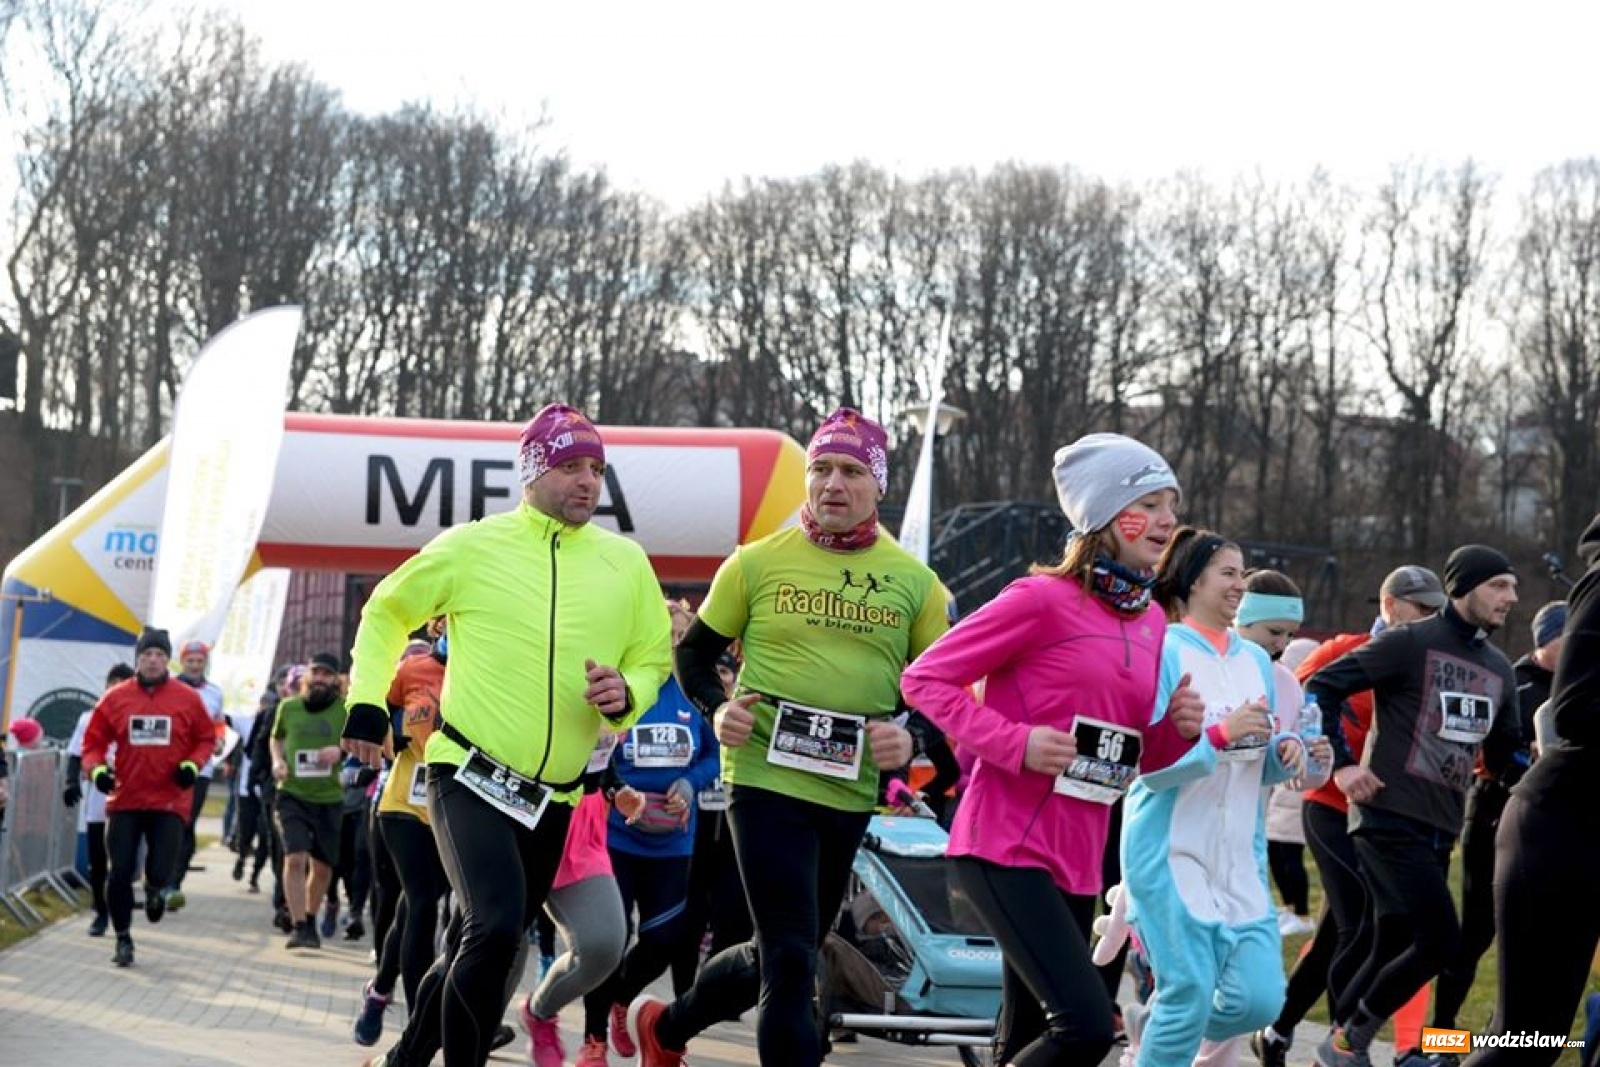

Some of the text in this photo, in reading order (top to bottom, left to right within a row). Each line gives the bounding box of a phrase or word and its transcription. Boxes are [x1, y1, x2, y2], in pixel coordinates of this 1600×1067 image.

[366, 454, 636, 533] MEA
[775, 583, 901, 629] Radlinioki
[806, 618, 874, 634] w biegu
[1460, 697, 1476, 718] 61
[649, 726, 678, 744] 128
[808, 714, 834, 739] 13
[1097, 729, 1126, 763] 56
